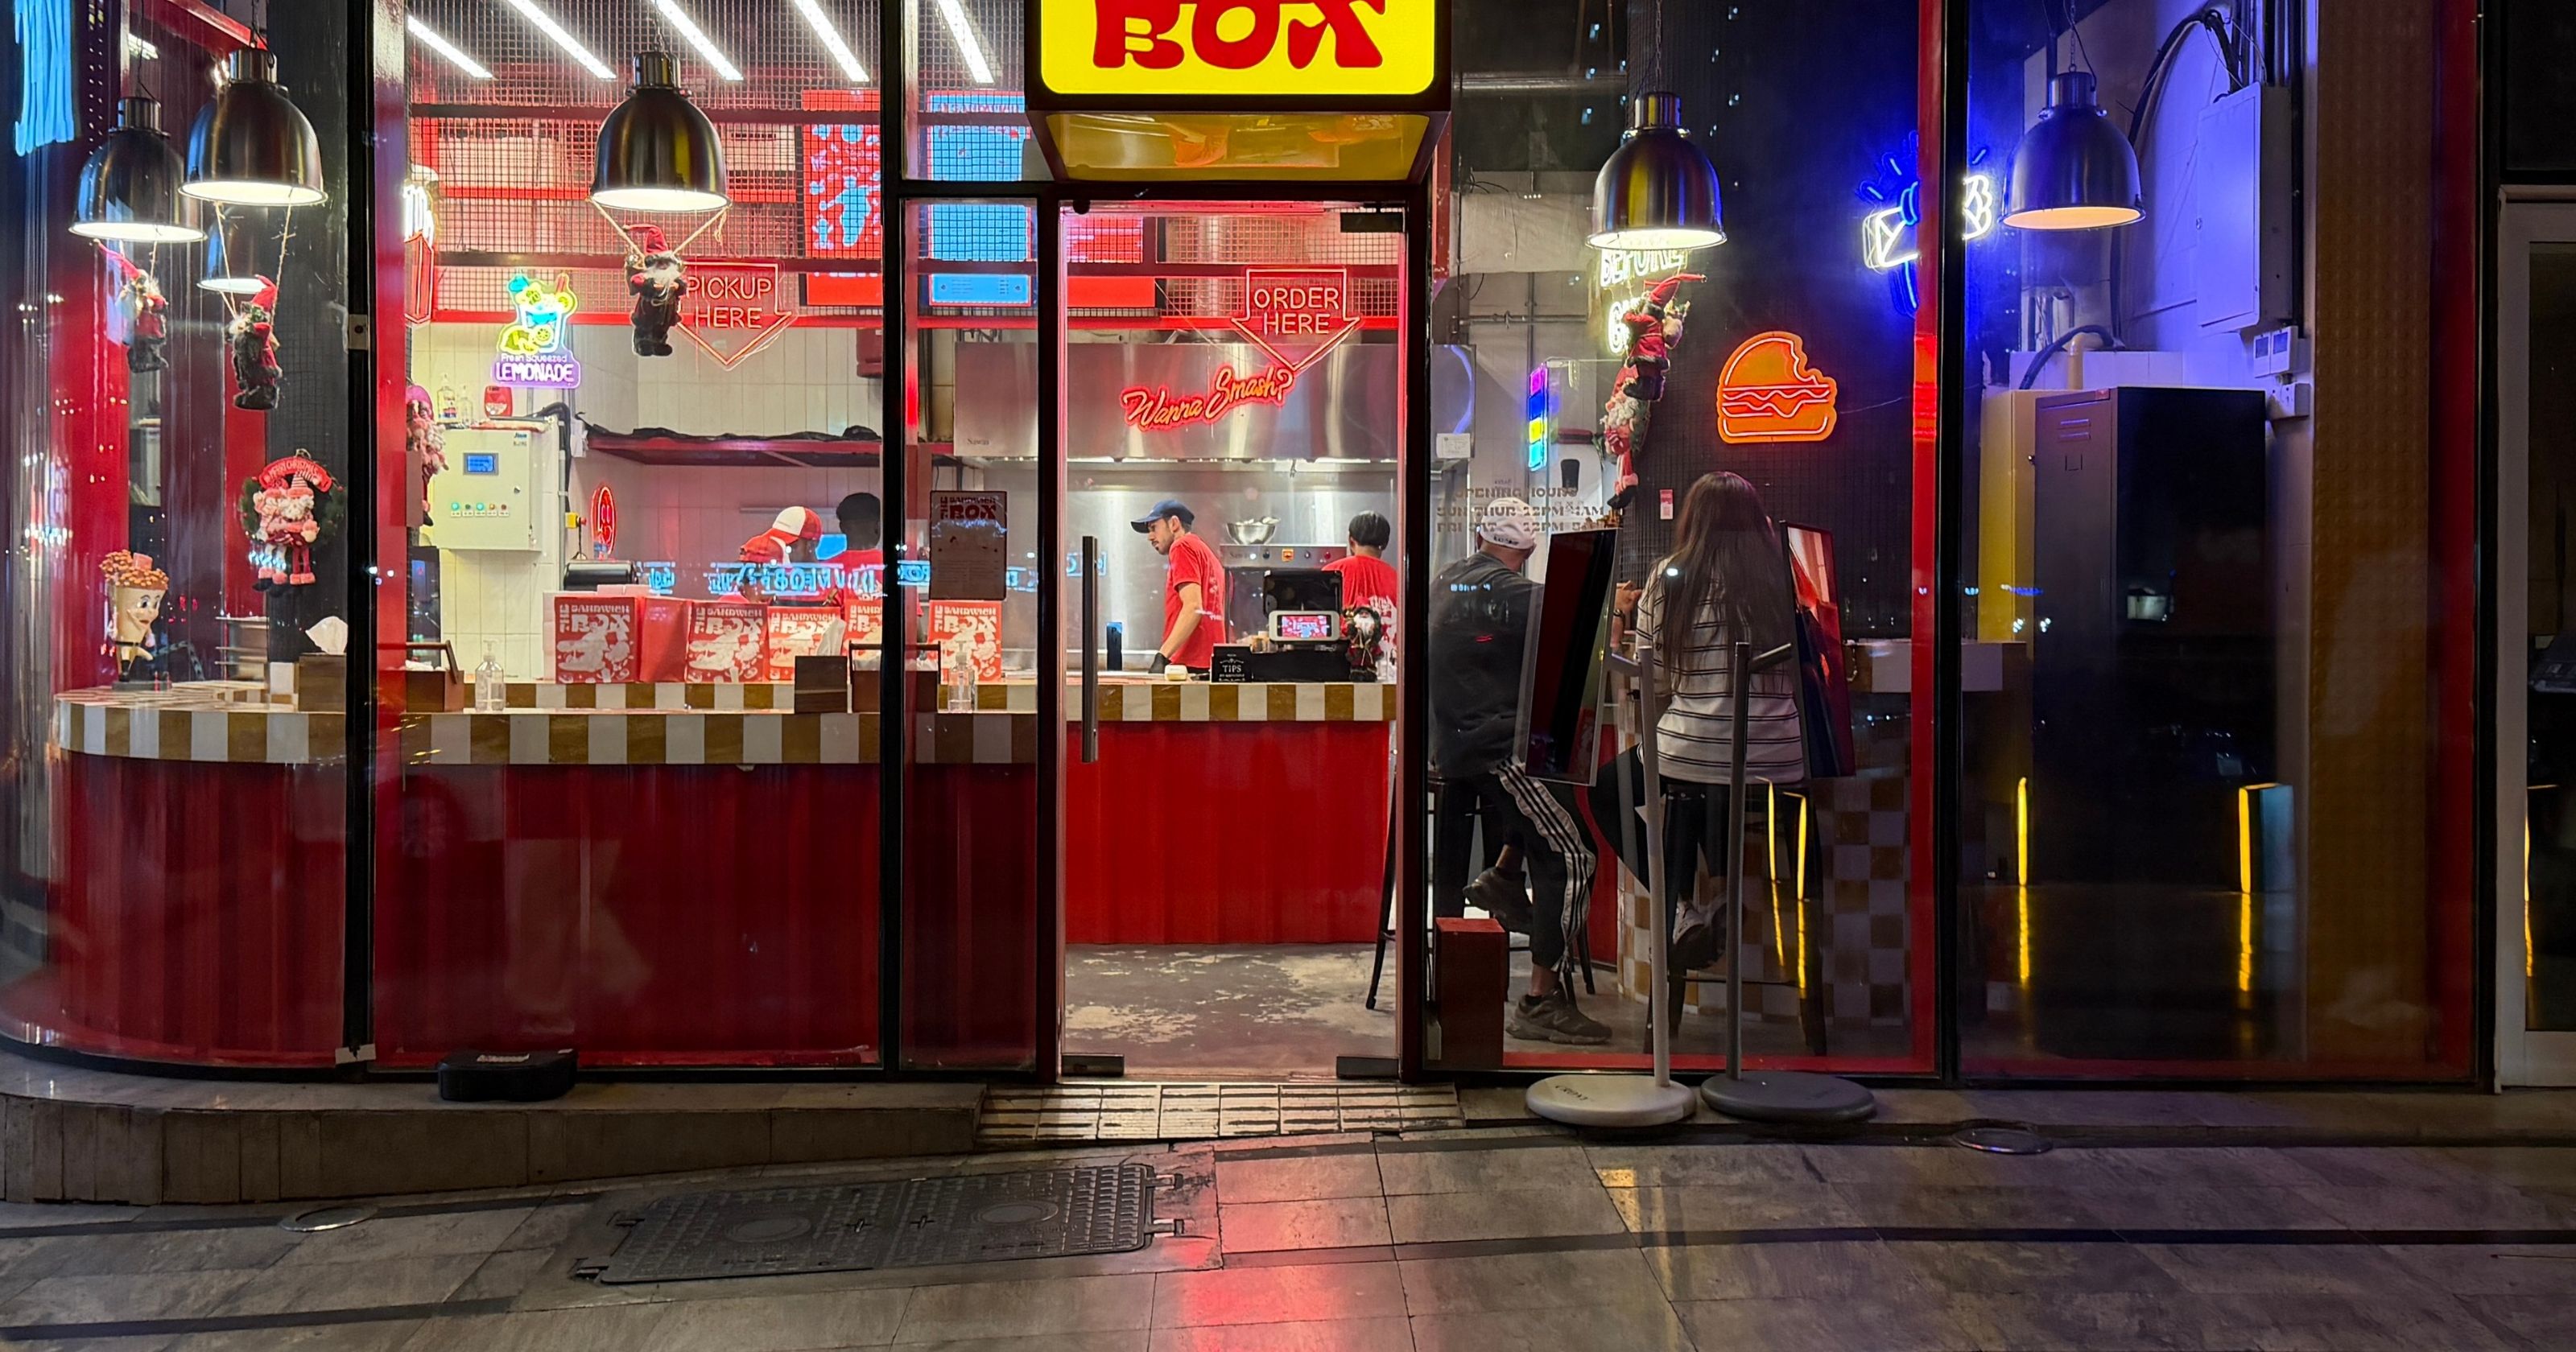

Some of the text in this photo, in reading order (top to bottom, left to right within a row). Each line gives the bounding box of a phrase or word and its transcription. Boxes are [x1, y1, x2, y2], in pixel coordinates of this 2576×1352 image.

[1092, 0, 1385, 70] BOX
[686, 275, 772, 299] PICKUP
[1253, 287, 1340, 309] ORDER
[695, 305, 763, 328] HERE
[1263, 311, 1331, 335] HERE
[496, 362, 574, 382] LEMONADE
[1123, 367, 1293, 426] Wanna Smash?
[1455, 487, 1522, 497] OPENING
[950, 504, 997, 520] BOX
[1474, 506, 1517, 517] THUR
[1523, 506, 1564, 517] 12PM
[1437, 521, 1463, 533] FRI
[1523, 521, 1564, 533] 12PM
[571, 604, 630, 613] SANDWICH
[707, 608, 762, 617] SANDWICH
[944, 606, 997, 615] SANDWICH
[1222, 665, 1241, 673] TIPS
